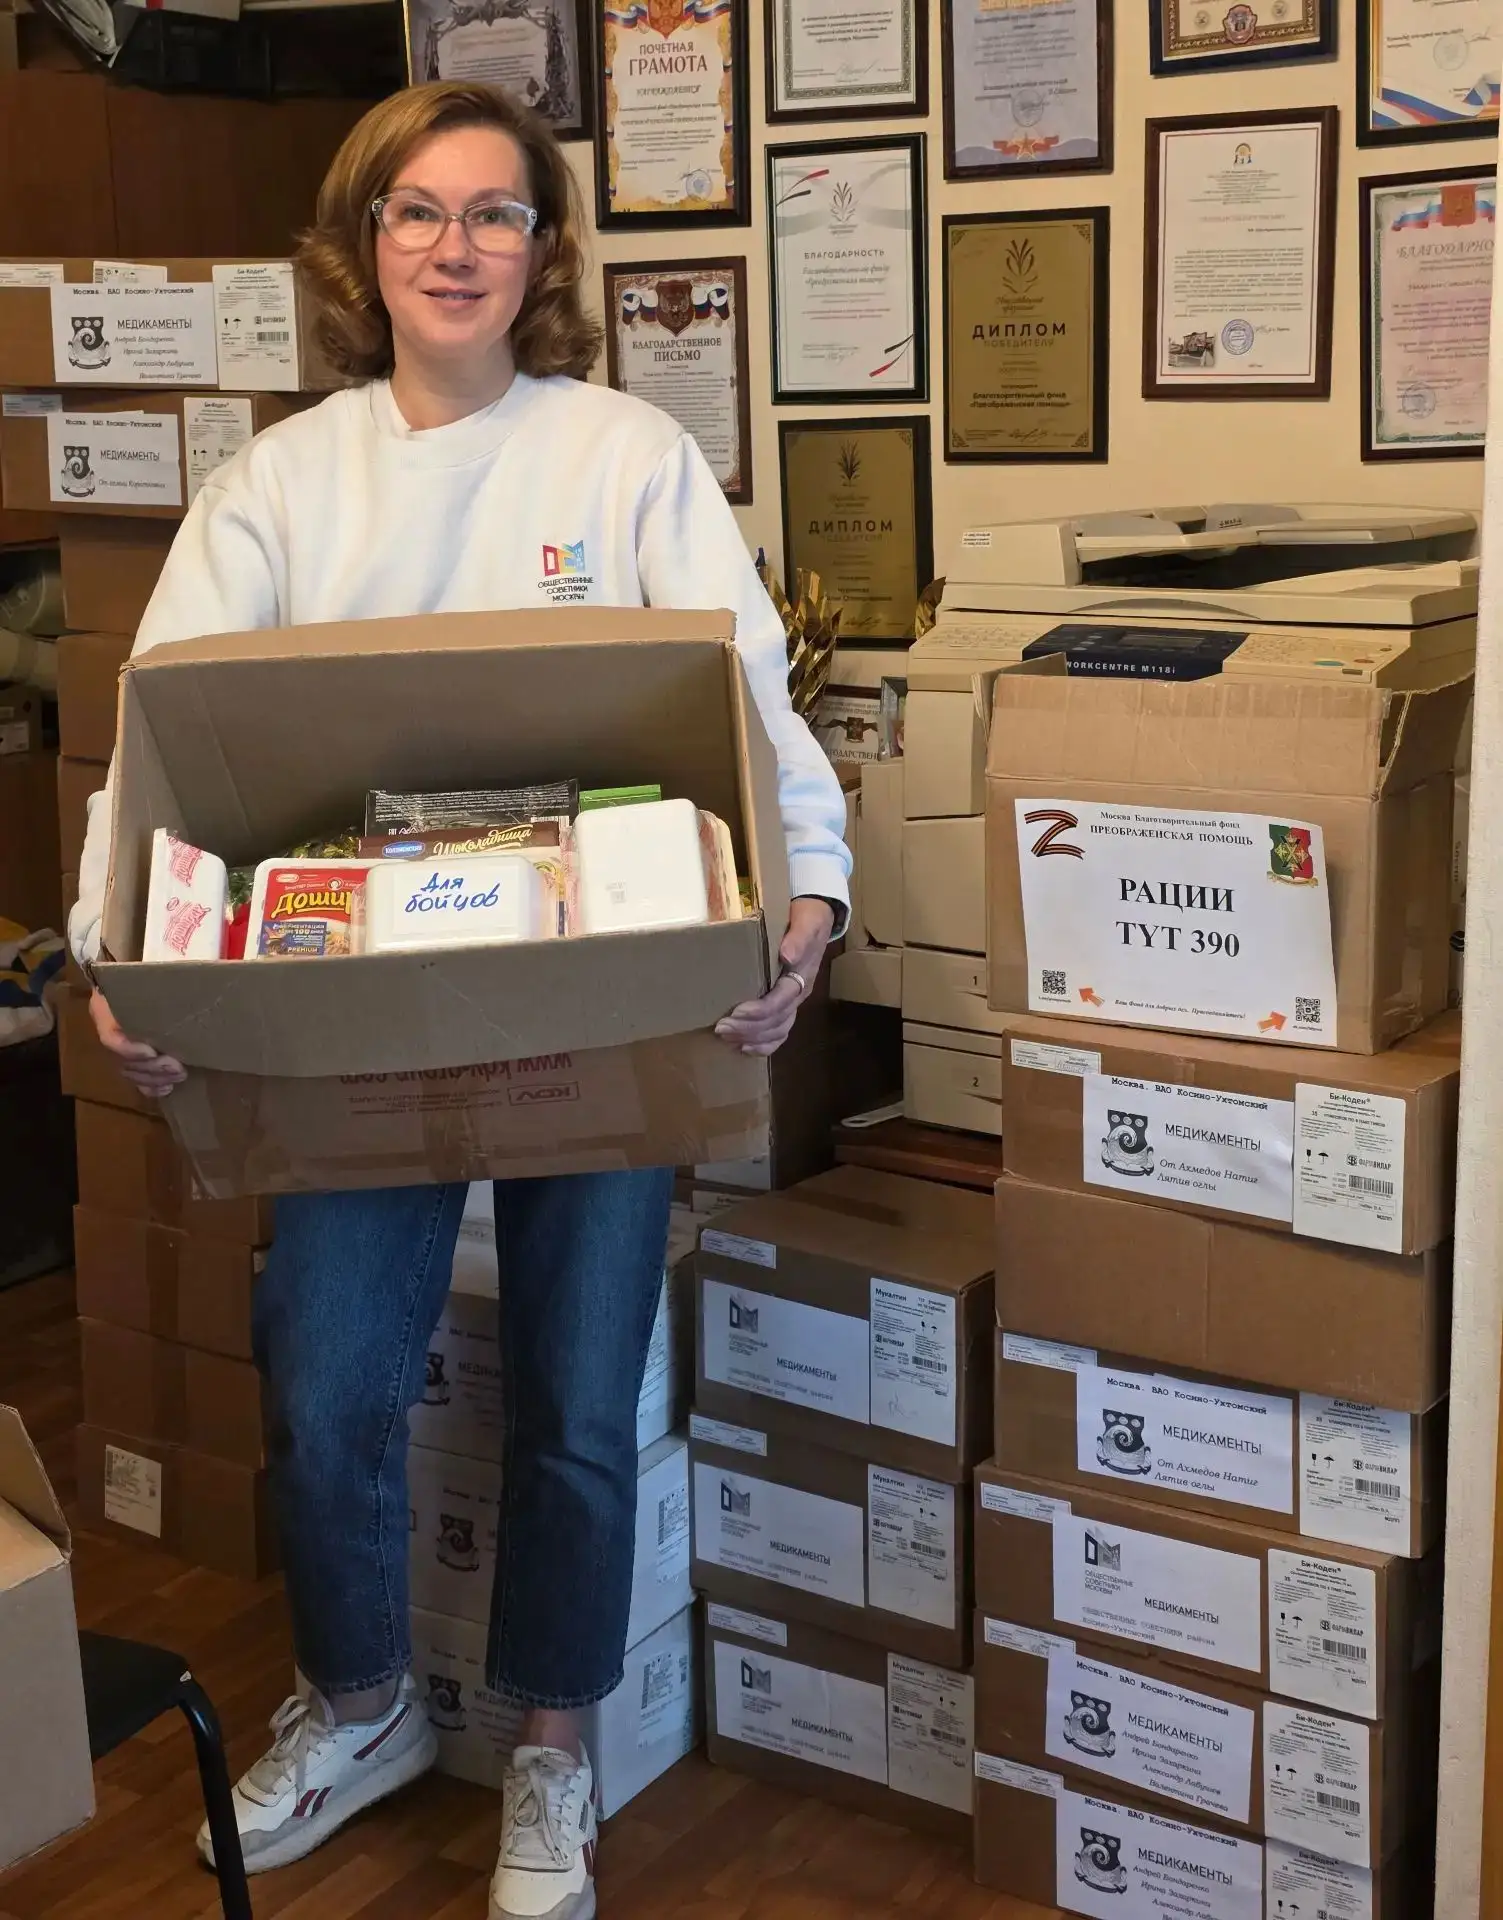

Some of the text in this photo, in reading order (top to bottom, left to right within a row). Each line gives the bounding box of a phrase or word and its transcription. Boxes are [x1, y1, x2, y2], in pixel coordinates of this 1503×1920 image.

[639, 41, 694, 55] ПОЧЕТНАЯ
[629, 55, 708, 76] ГРАМОТА
[804, 249, 885, 260] БЛАГОДАРНОСТЬ
[1397, 239, 1495, 258] БЛАГОДАРНО
[117, 318, 193, 330] МЕДИКАМЕНТЫ
[972, 322, 1066, 340] ДИПЛОМ
[632, 338, 722, 350] БЛАГОДАРСТВЕННОЕ
[654, 350, 701, 362] ПИСЬМО
[100, 450, 160, 462] МЕДИКАМЕНТЫ
[808, 520, 893, 535] ДИПЛОМ
[1100, 811, 1241, 829] Москва Благотворительный фонд
[433, 823, 534, 856] Шоколадница
[1090, 825, 1253, 846] ПРЕОБРАЖЕНСКАЯ ПОМОЩЬ
[420, 872, 464, 893] Для
[270, 891, 352, 919] Дошир
[404, 883, 500, 913] бойцов
[1117, 877, 1235, 914] РАЦИИ
[1190, 929, 1240, 958] 390
[972, 975, 978, 986] 1
[972, 1076, 980, 1088] 2
[515, 1086, 571, 1101] KDV
[1111, 1076, 1269, 1111] Москва. ВАО Косино-Ухтомский
[1165, 1123, 1262, 1152] МЕДИКАМЕНТЫ
[1159, 1158, 1260, 1184] От Ахмедов Натиг
[1192, 1180, 1217, 1192] оглы
[875, 1288, 907, 1302] Мукалтин
[776, 1356, 838, 1381] МЕДИКАМЕНТЫ
[1107, 1377, 1267, 1415] Москва. ВАО Косино-Ухтомский
[1163, 1424, 1262, 1455] МЕДИКАМЕНТЫ
[1157, 1458, 1259, 1486] От Ахмедов Натиг
[1191, 1481, 1215, 1492] оглы
[769, 1539, 831, 1567] МЕДИКАМЕНТЫ
[1144, 1597, 1219, 1624] МЕДИКАМЕНТЫ
[1076, 1660, 1229, 1717] Москва. ВАО Косино-Ухтомский
[791, 1717, 853, 1743] МЕДИКАМЕНТЫ
[1128, 1712, 1223, 1753] МЕДИКАМЕНТЫ
[1122, 1729, 1199, 1760] Андрей Бондаренко
[1132, 1747, 1157, 1761] Ирина
[1142, 1764, 1184, 1783] Александр
[1149, 1780, 1229, 1812] Валентина Грачева
[1084, 1797, 1238, 1848] Москва. ВАО Косино-Ухтомский
[1138, 1848, 1233, 1886] МЕДИКАМЕНТЫ
[1132, 1864, 1210, 1894] Андрей Бондаренко
[1140, 1880, 1166, 1895] Ирина
[1152, 1898, 1194, 1917] Александр
